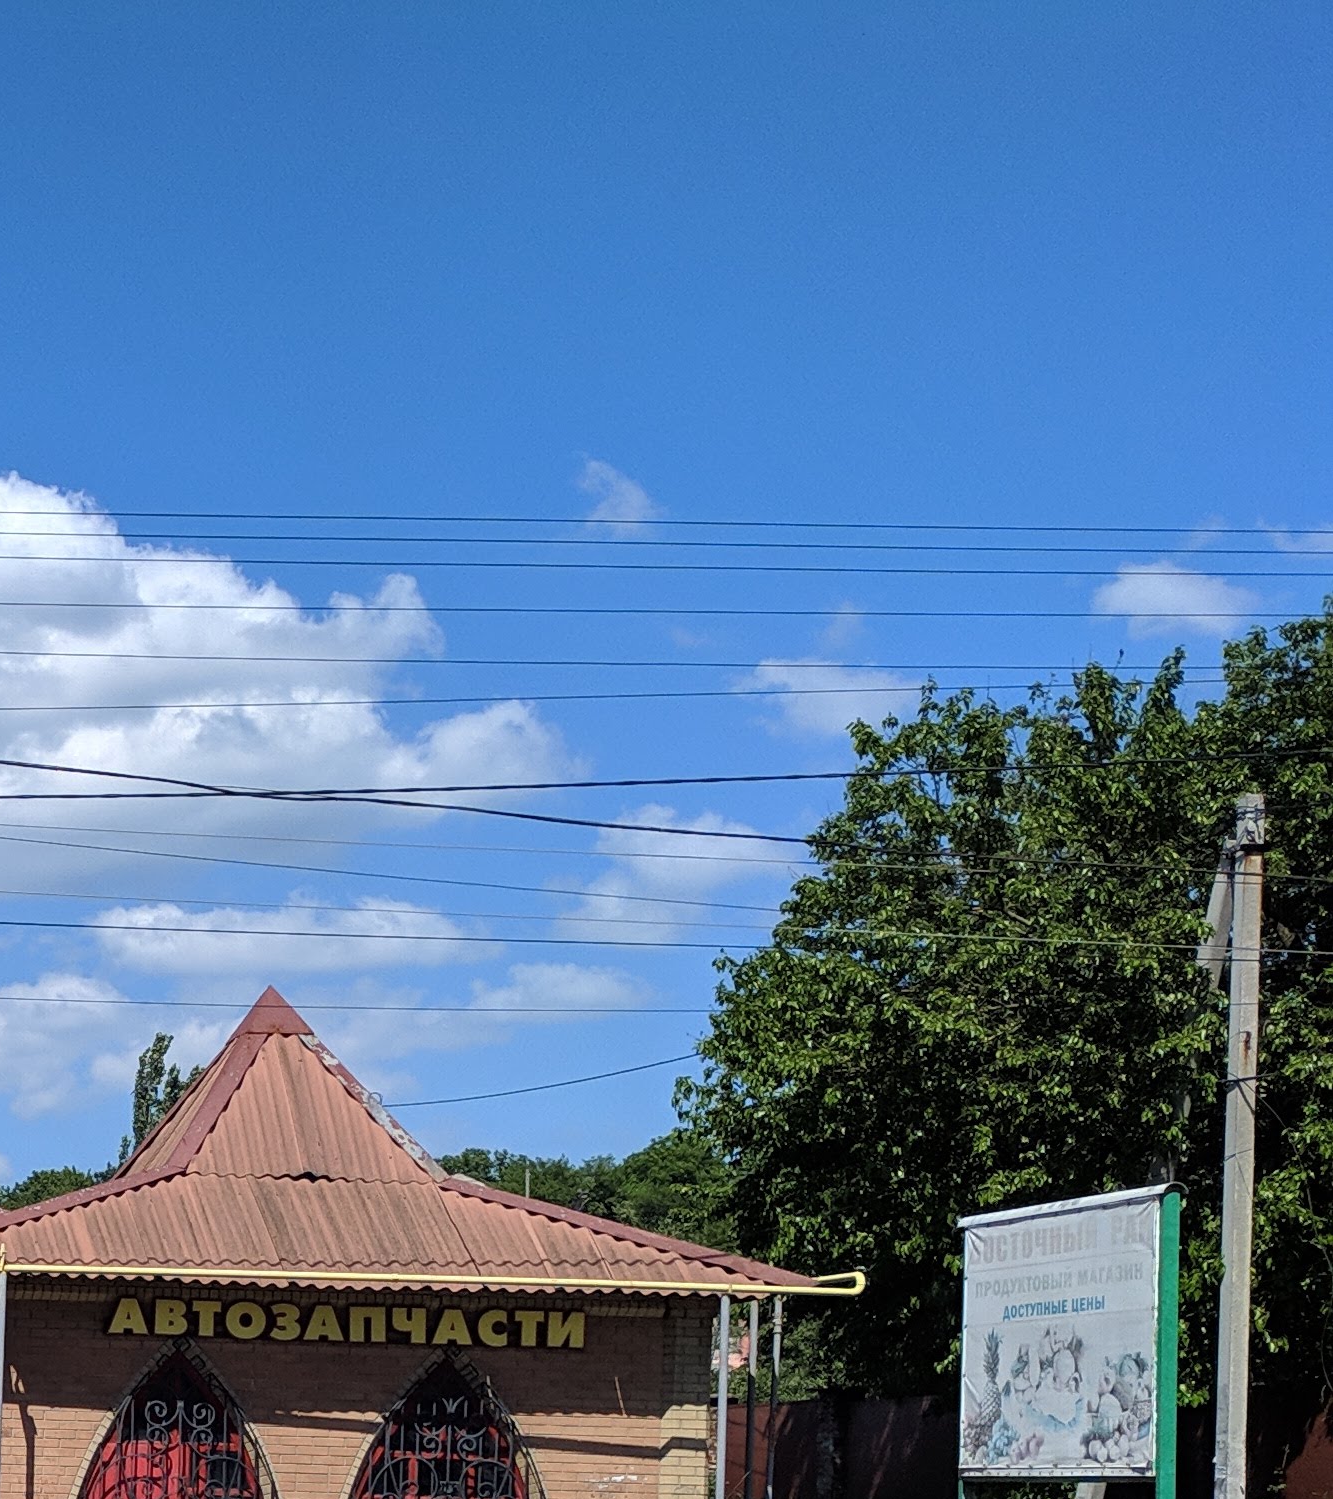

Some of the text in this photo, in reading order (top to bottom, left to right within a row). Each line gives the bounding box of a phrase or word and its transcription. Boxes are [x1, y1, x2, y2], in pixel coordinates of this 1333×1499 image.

[975, 1263, 1143, 1298] ПРОДУКТОВЫЙ МАГАЗИН
[108, 1298, 585, 1348] АВТОЗАПЧАСТИ
[1002, 1295, 1105, 1322] ДОСТУПНЫЕ ЦЕНЫ
